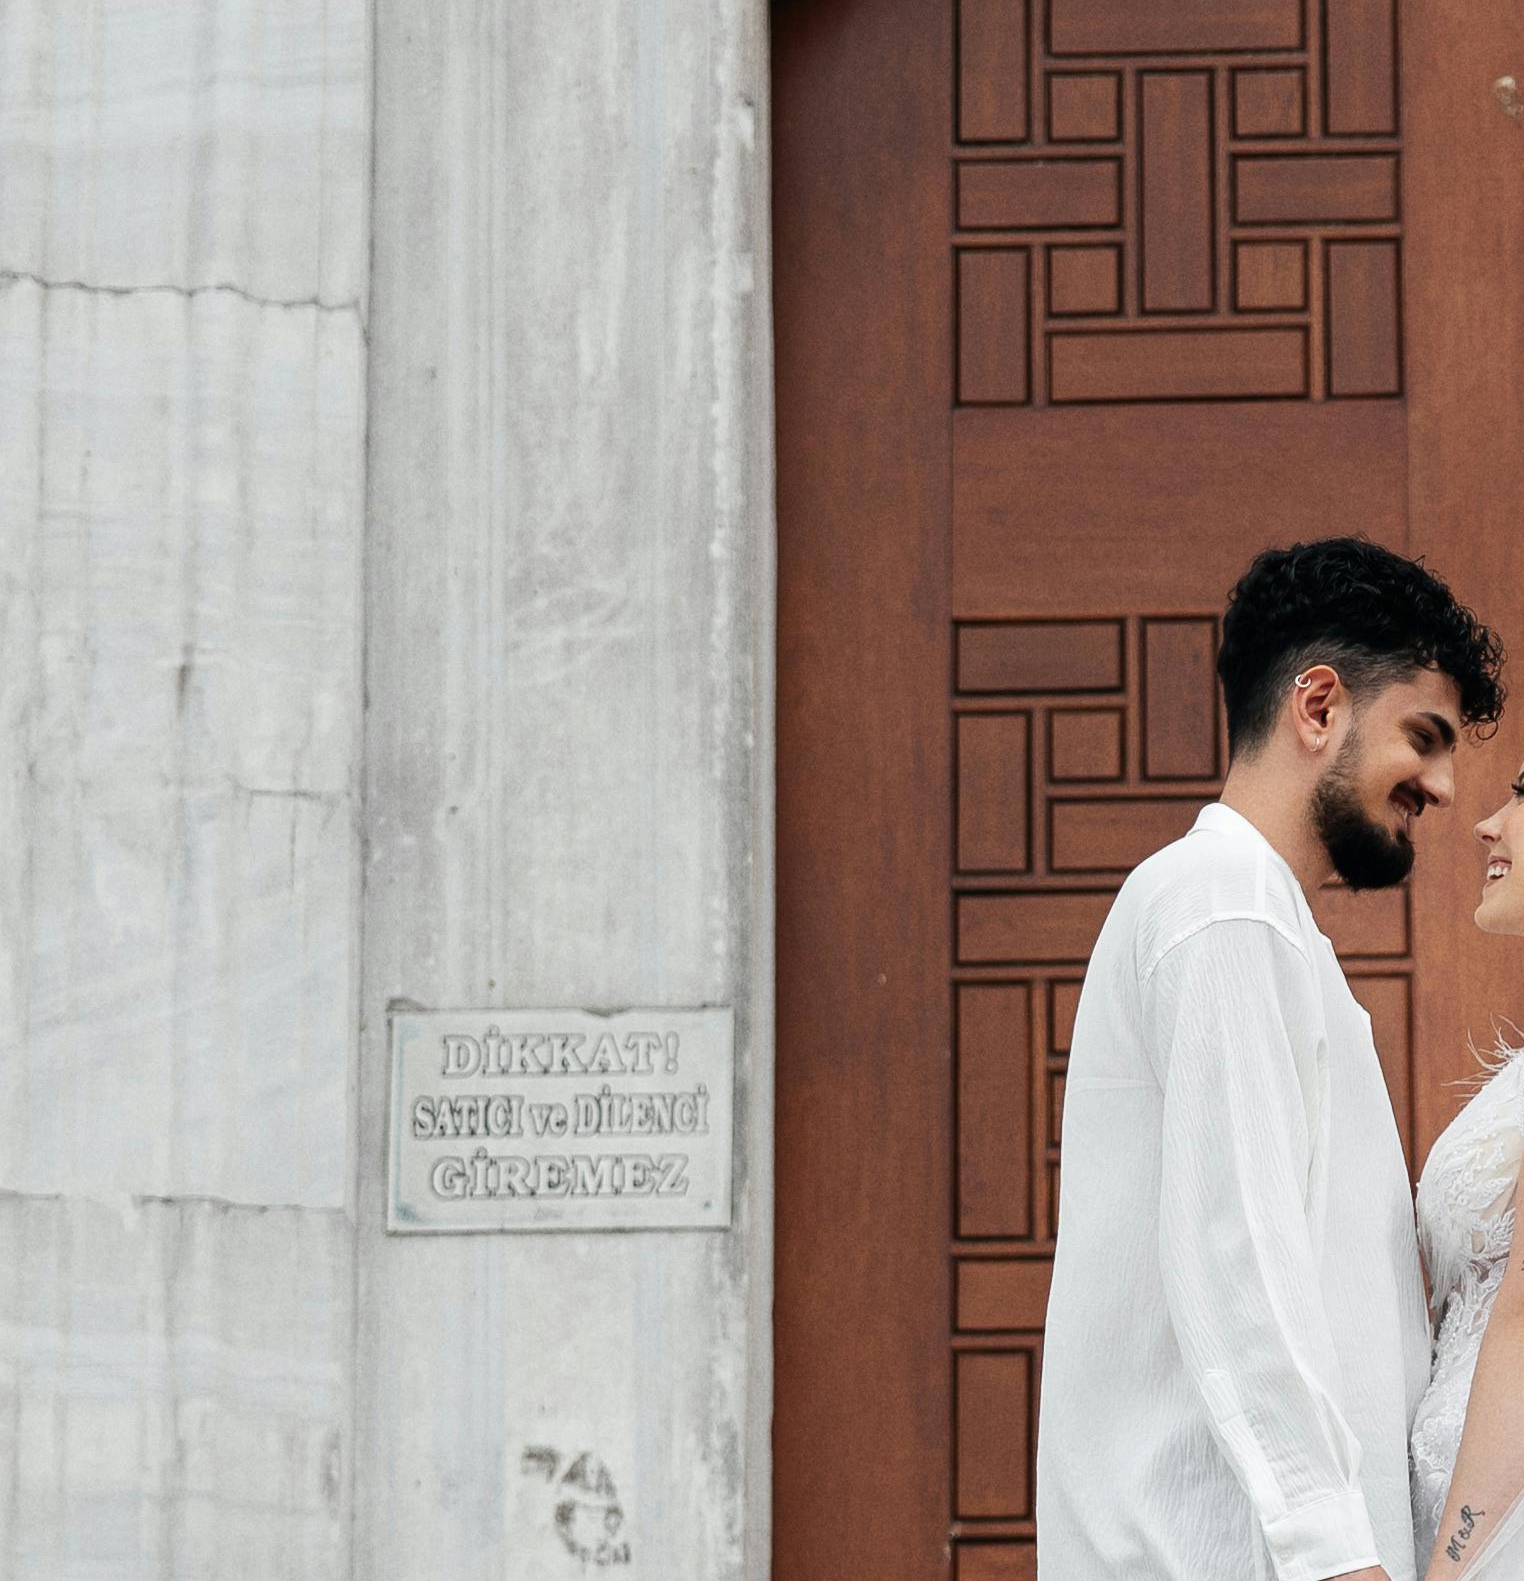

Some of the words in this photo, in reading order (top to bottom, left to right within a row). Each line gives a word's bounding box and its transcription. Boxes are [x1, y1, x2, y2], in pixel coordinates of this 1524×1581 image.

[441, 1025, 681, 1079] DİKKAT!
[411, 1094, 526, 1140] SATICI
[528, 1102, 569, 1138] ve
[573, 1084, 711, 1138] DİLENCİ
[430, 1147, 691, 1202] GİREMEZ
